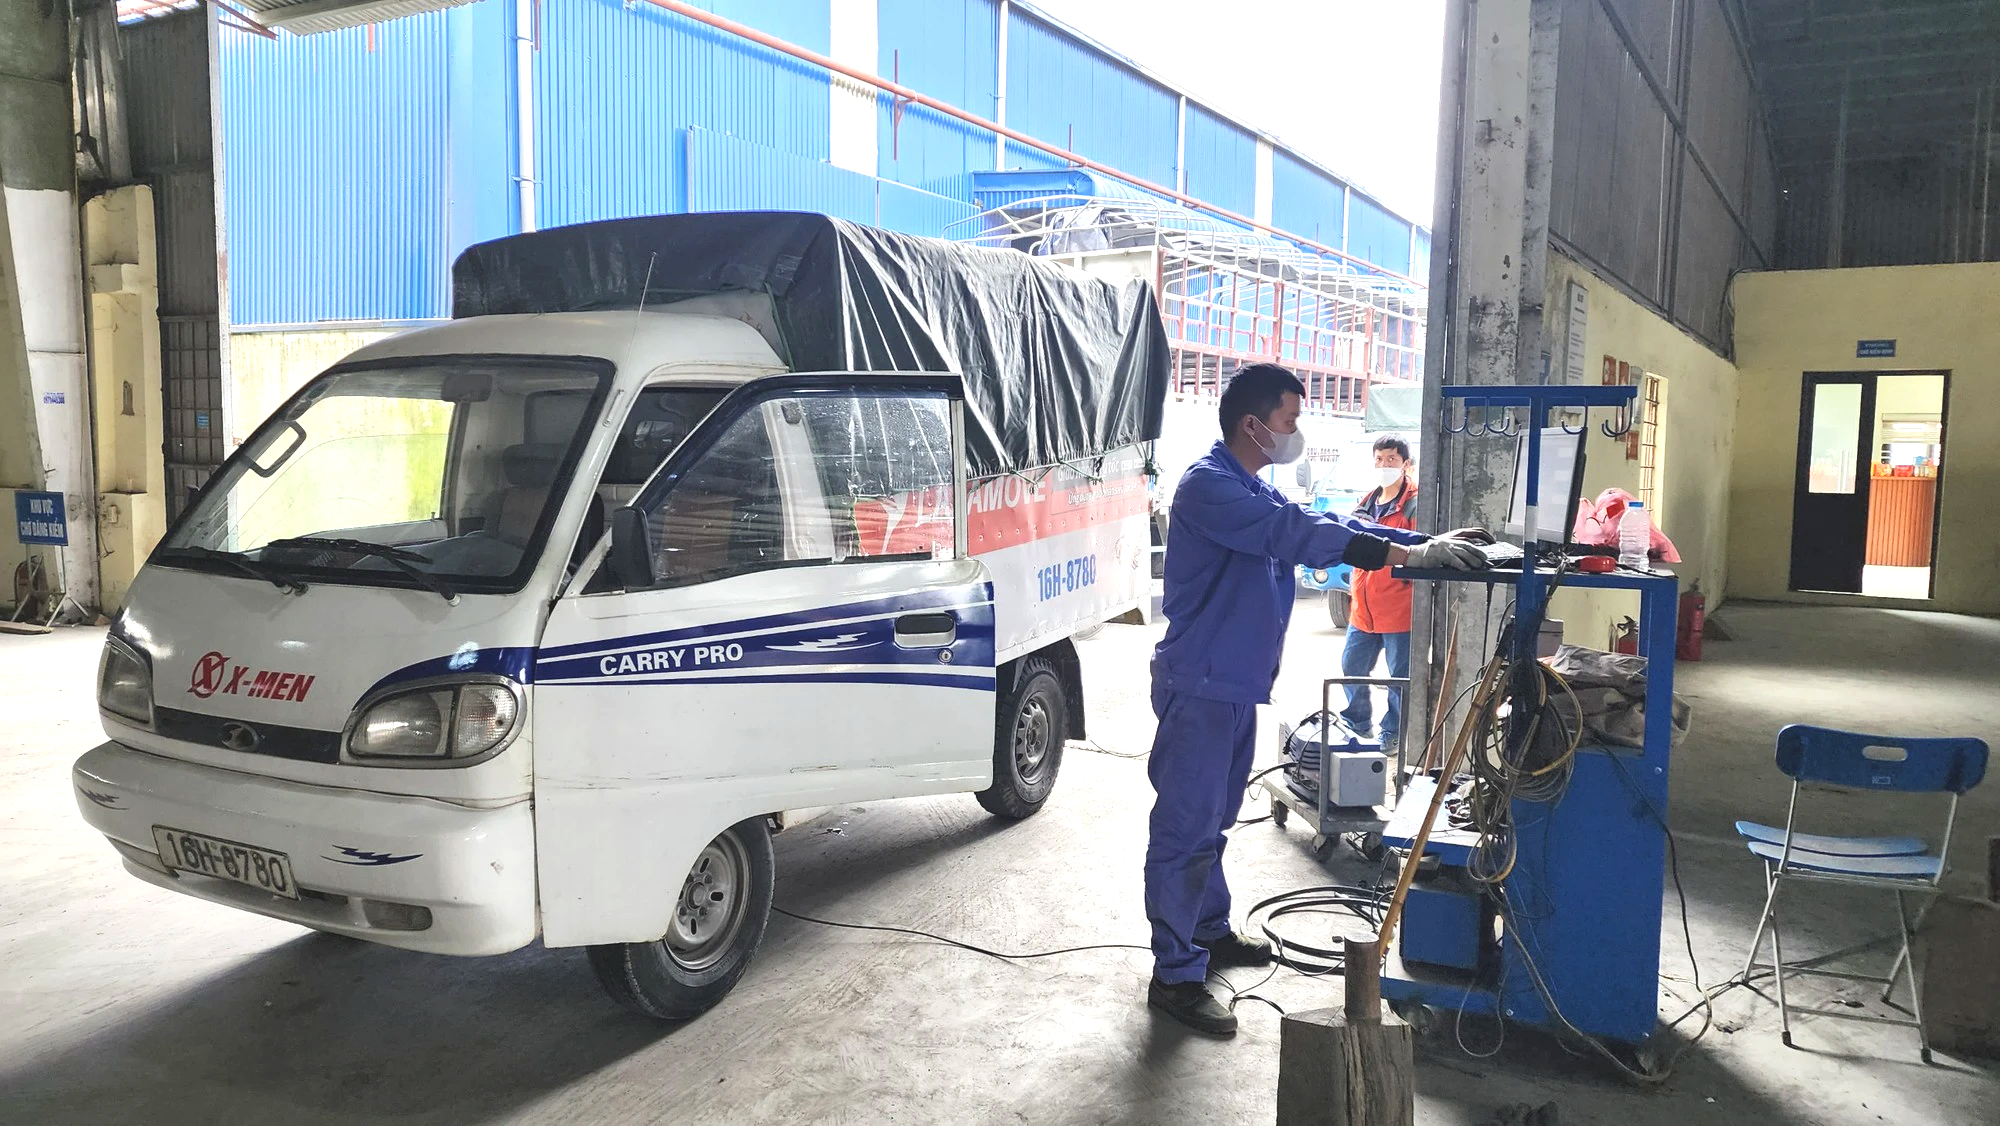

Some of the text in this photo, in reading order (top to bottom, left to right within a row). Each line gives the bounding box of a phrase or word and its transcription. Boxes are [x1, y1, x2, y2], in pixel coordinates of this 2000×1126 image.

[30, 499, 42, 514] KHU
[1038, 554, 1097, 602] 16H-8780
[600, 643, 744, 675] CARRY PRO
[222, 665, 316, 703] X-MEN
[167, 832, 287, 892] 16H-8780
